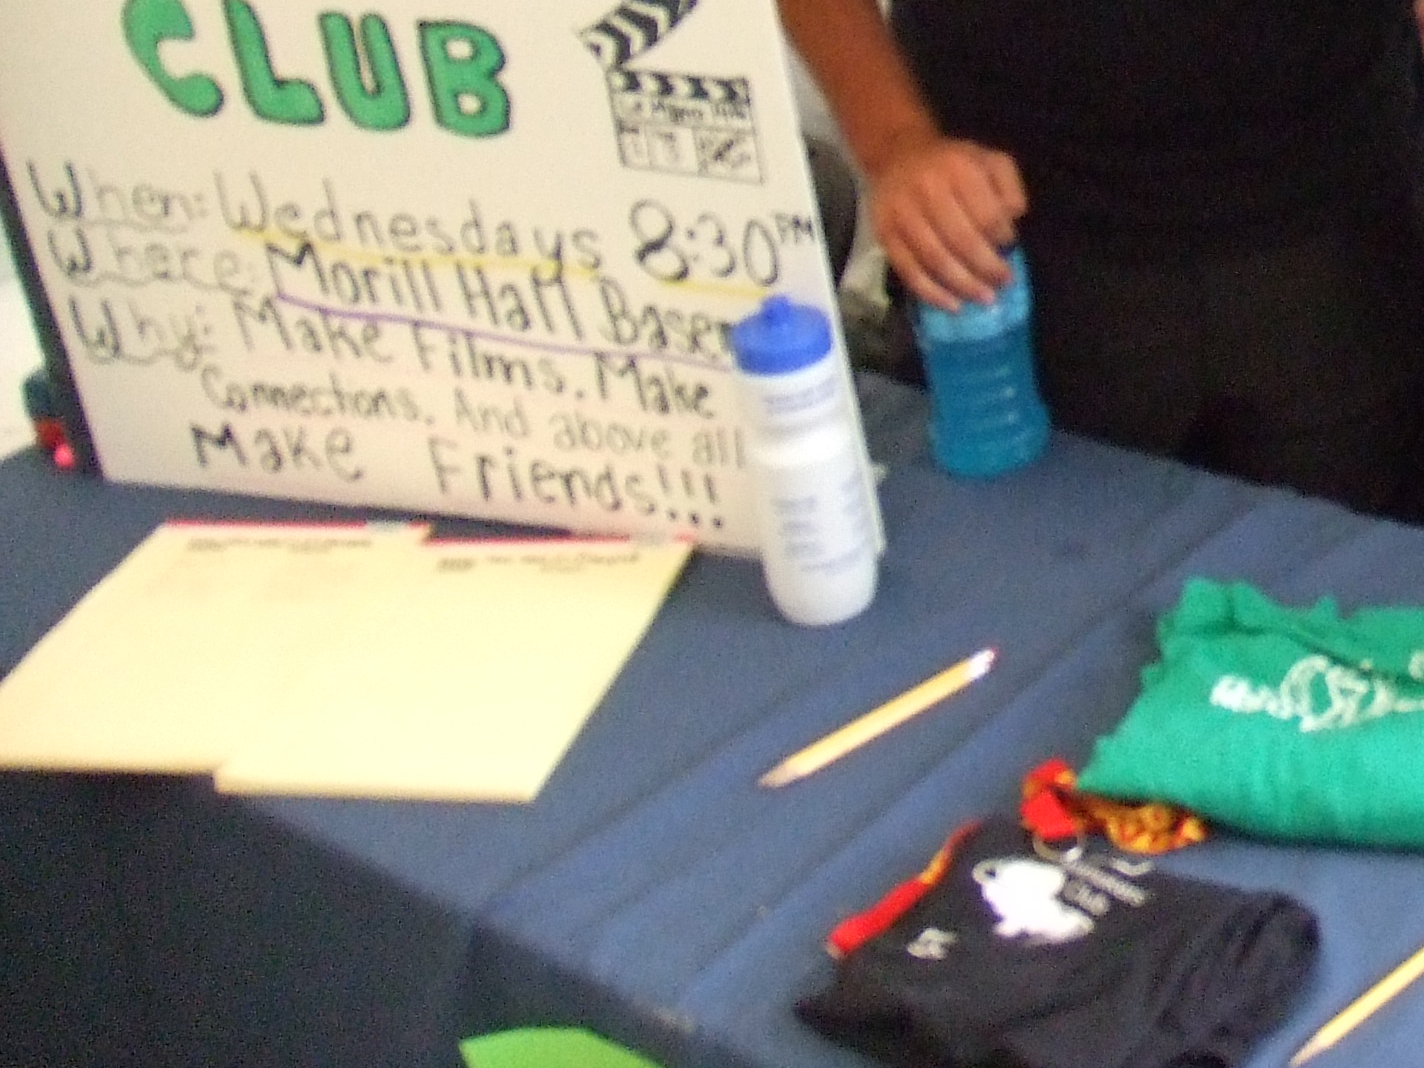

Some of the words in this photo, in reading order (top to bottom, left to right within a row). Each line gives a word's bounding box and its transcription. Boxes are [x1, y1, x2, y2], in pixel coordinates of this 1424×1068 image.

[213, 170, 601, 288] Wednesdays
[265, 241, 441, 315] Morill
[456, 261, 584, 342] Hall
[69, 296, 213, 372] Why:
[232, 294, 393, 364] Make
[595, 351, 716, 420] Make
[190, 421, 364, 483] Make
[427, 435, 724, 529] Friends!!!
[454, 385, 532, 440] And
[548, 410, 670, 460] above
[692, 425, 746, 469] all
